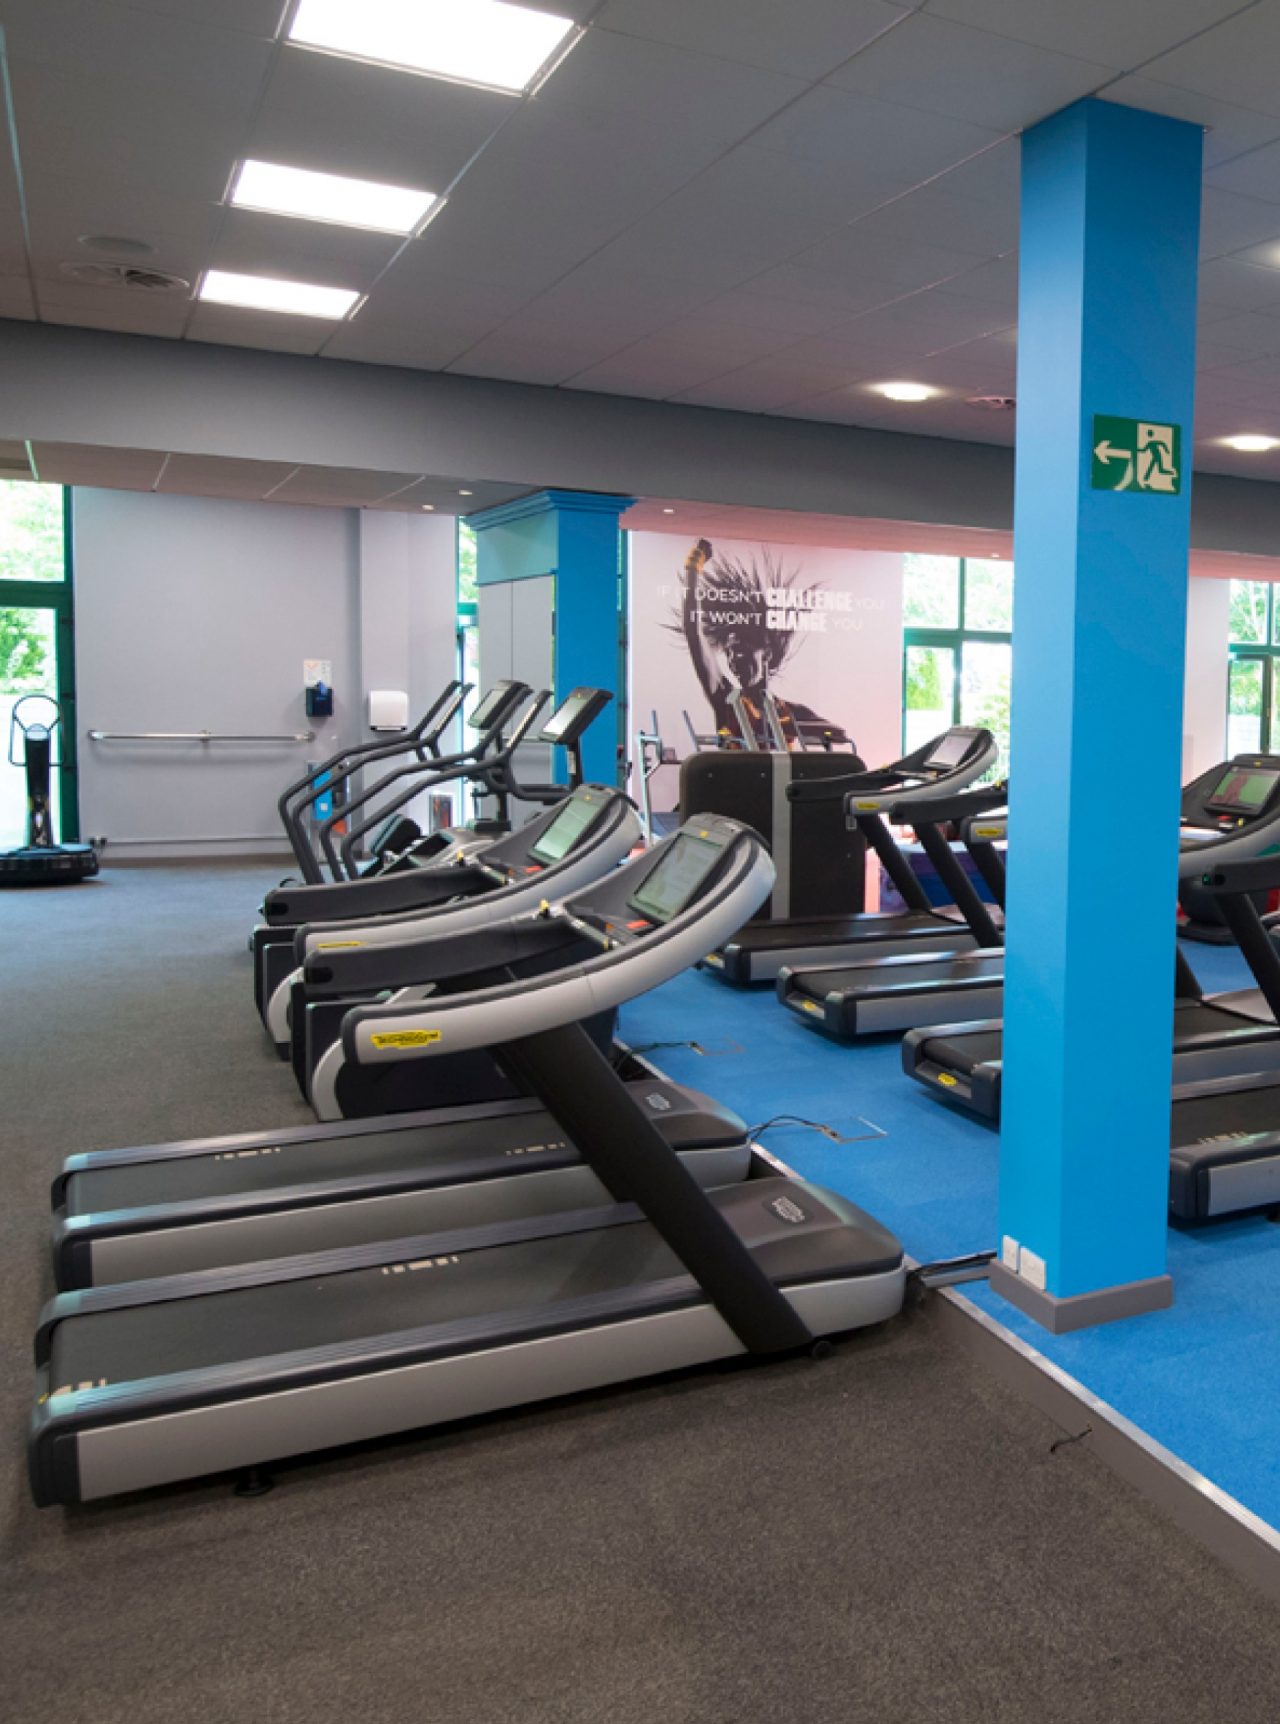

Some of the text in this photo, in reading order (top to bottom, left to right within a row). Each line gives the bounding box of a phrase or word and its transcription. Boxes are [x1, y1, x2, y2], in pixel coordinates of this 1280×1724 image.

[695, 588, 762, 603] DOESN'T
[766, 587, 852, 612] CHALLENGE
[689, 610, 704, 622] IT
[709, 610, 762, 625] WON'T
[765, 610, 827, 632] CHANGE
